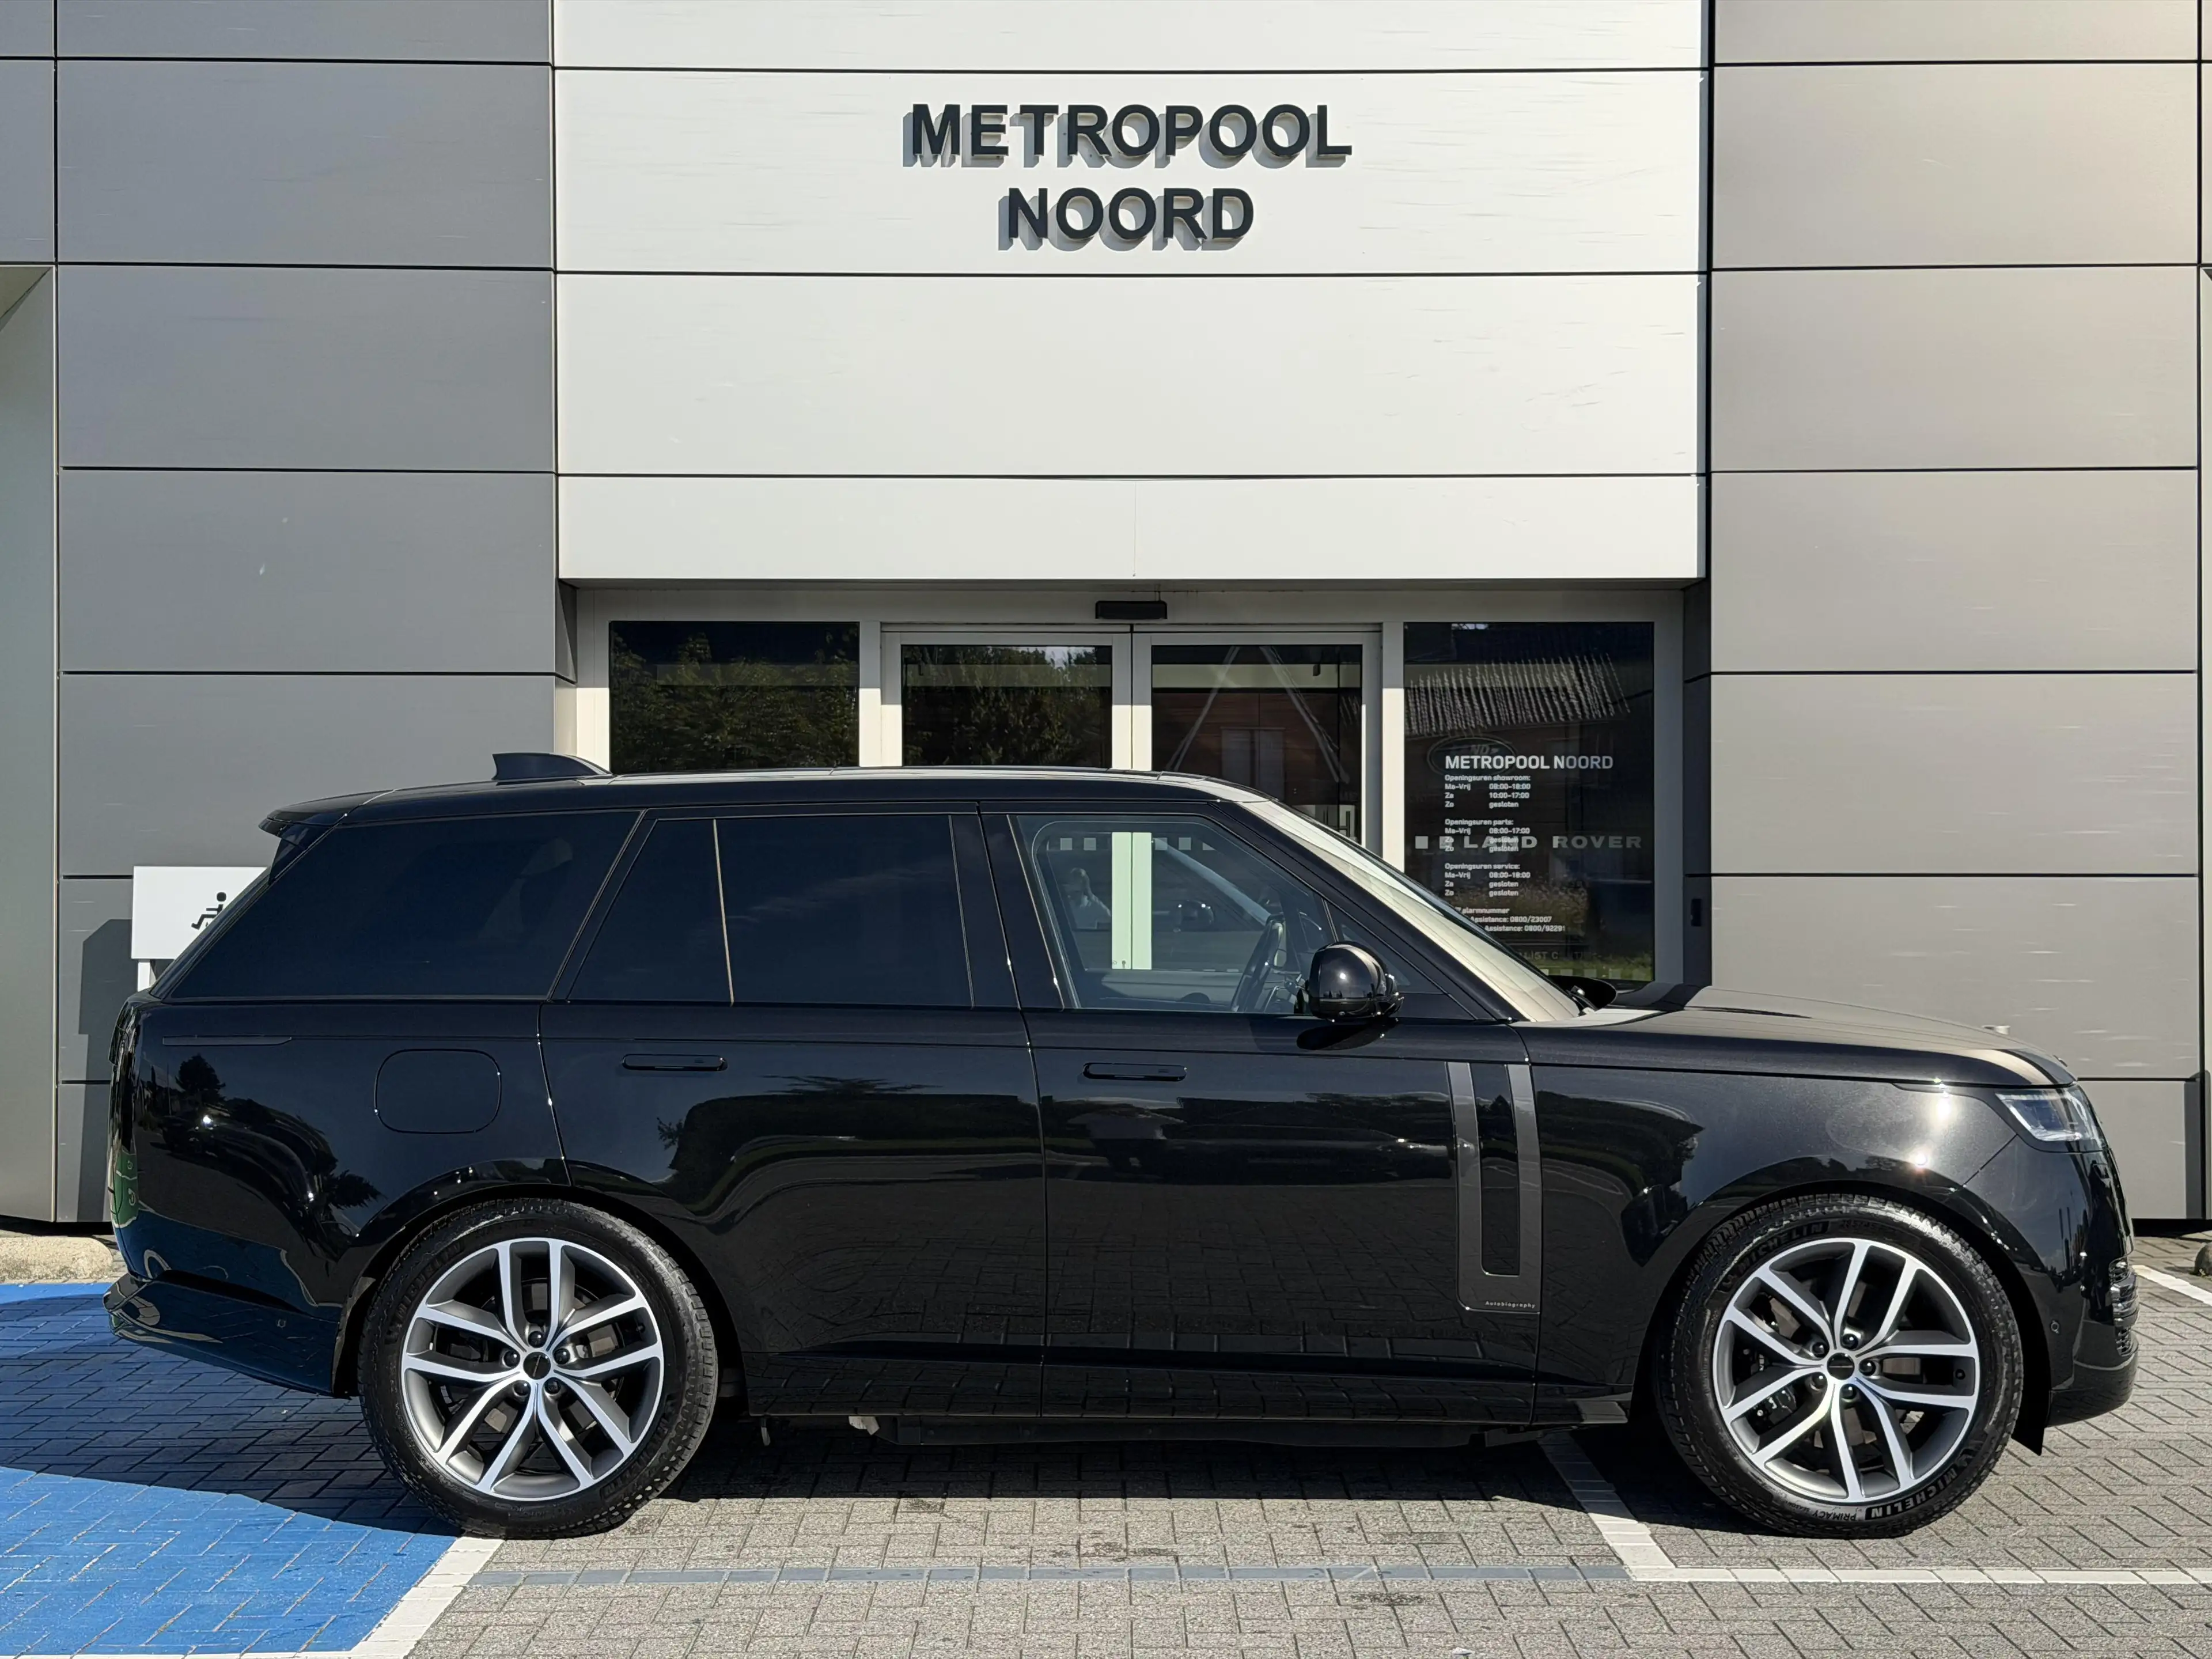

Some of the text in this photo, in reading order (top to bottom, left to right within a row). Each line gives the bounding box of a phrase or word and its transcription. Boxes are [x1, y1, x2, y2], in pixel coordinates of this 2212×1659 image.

[912, 104, 1353, 157] METROPOOL
[1008, 187, 1254, 240] NOORD
[1445, 755, 1613, 770] METROPOOL NOORD
[1445, 774, 1492, 782] Openingsuren
[1488, 801, 1519, 809] gesloten
[1445, 819, 1492, 827] Openingsuren
[1552, 836, 1642, 849] ROVER
[1488, 844, 1518, 853] gesloten
[1445, 862, 1492, 871] Openingsuren
[1445, 872, 1471, 880] Ma-Vrij
[1488, 889, 1518, 897] gesloten
[1510, 915, 1552, 923] 0800/23007
[1871, 1468, 1957, 1518] MICHELIN
[1812, 1510, 1857, 1521] PRIMACY
